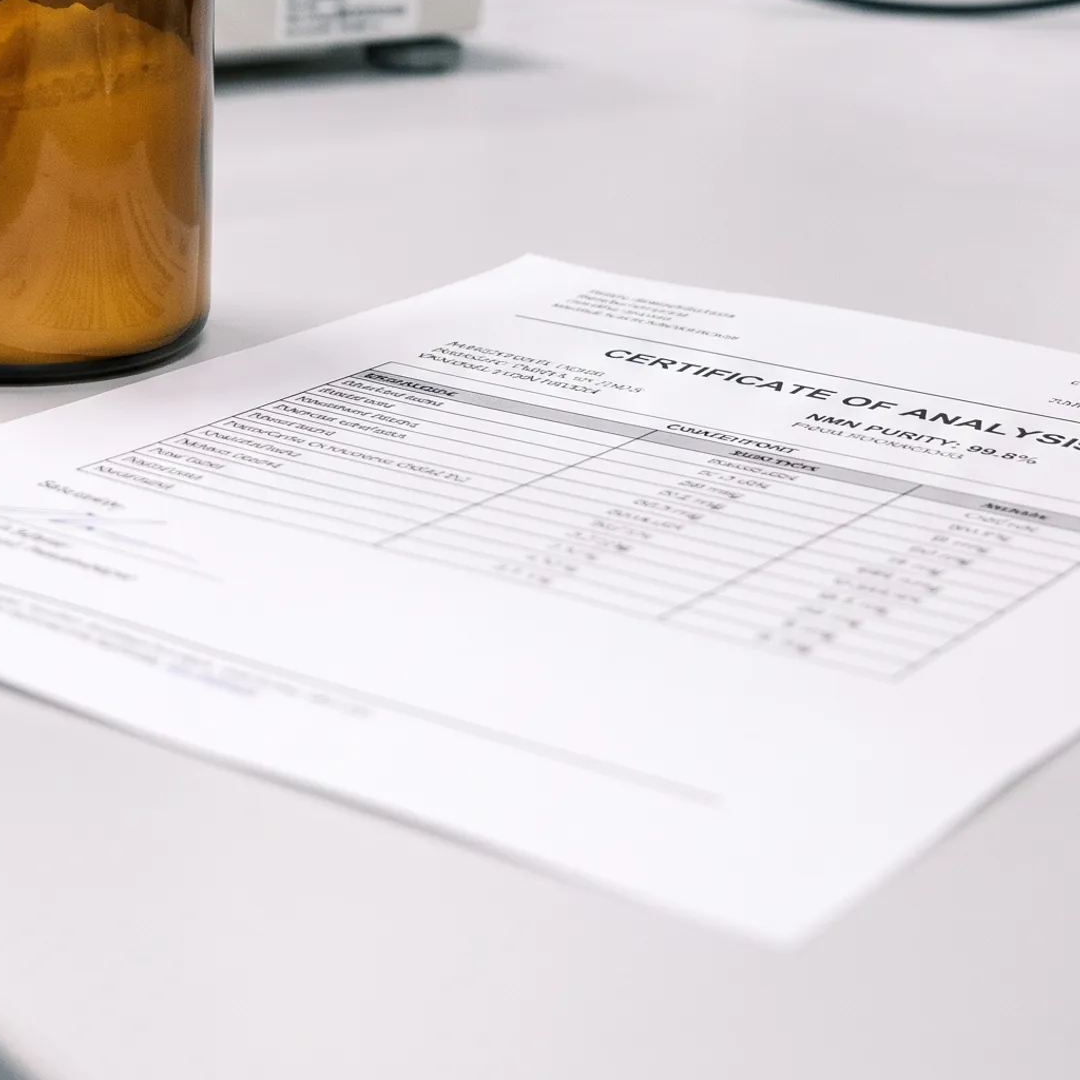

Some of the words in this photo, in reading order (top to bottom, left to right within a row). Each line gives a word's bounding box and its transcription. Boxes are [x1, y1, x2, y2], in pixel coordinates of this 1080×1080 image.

[604, 349, 838, 401] CERTIFICATE
[842, 396, 898, 411] OF
[898, 408, 1080, 451] ANALYSI
[805, 413, 862, 429] NMN
[864, 425, 961, 449] PURITY:
[966, 445, 1038, 464] 99.8%
